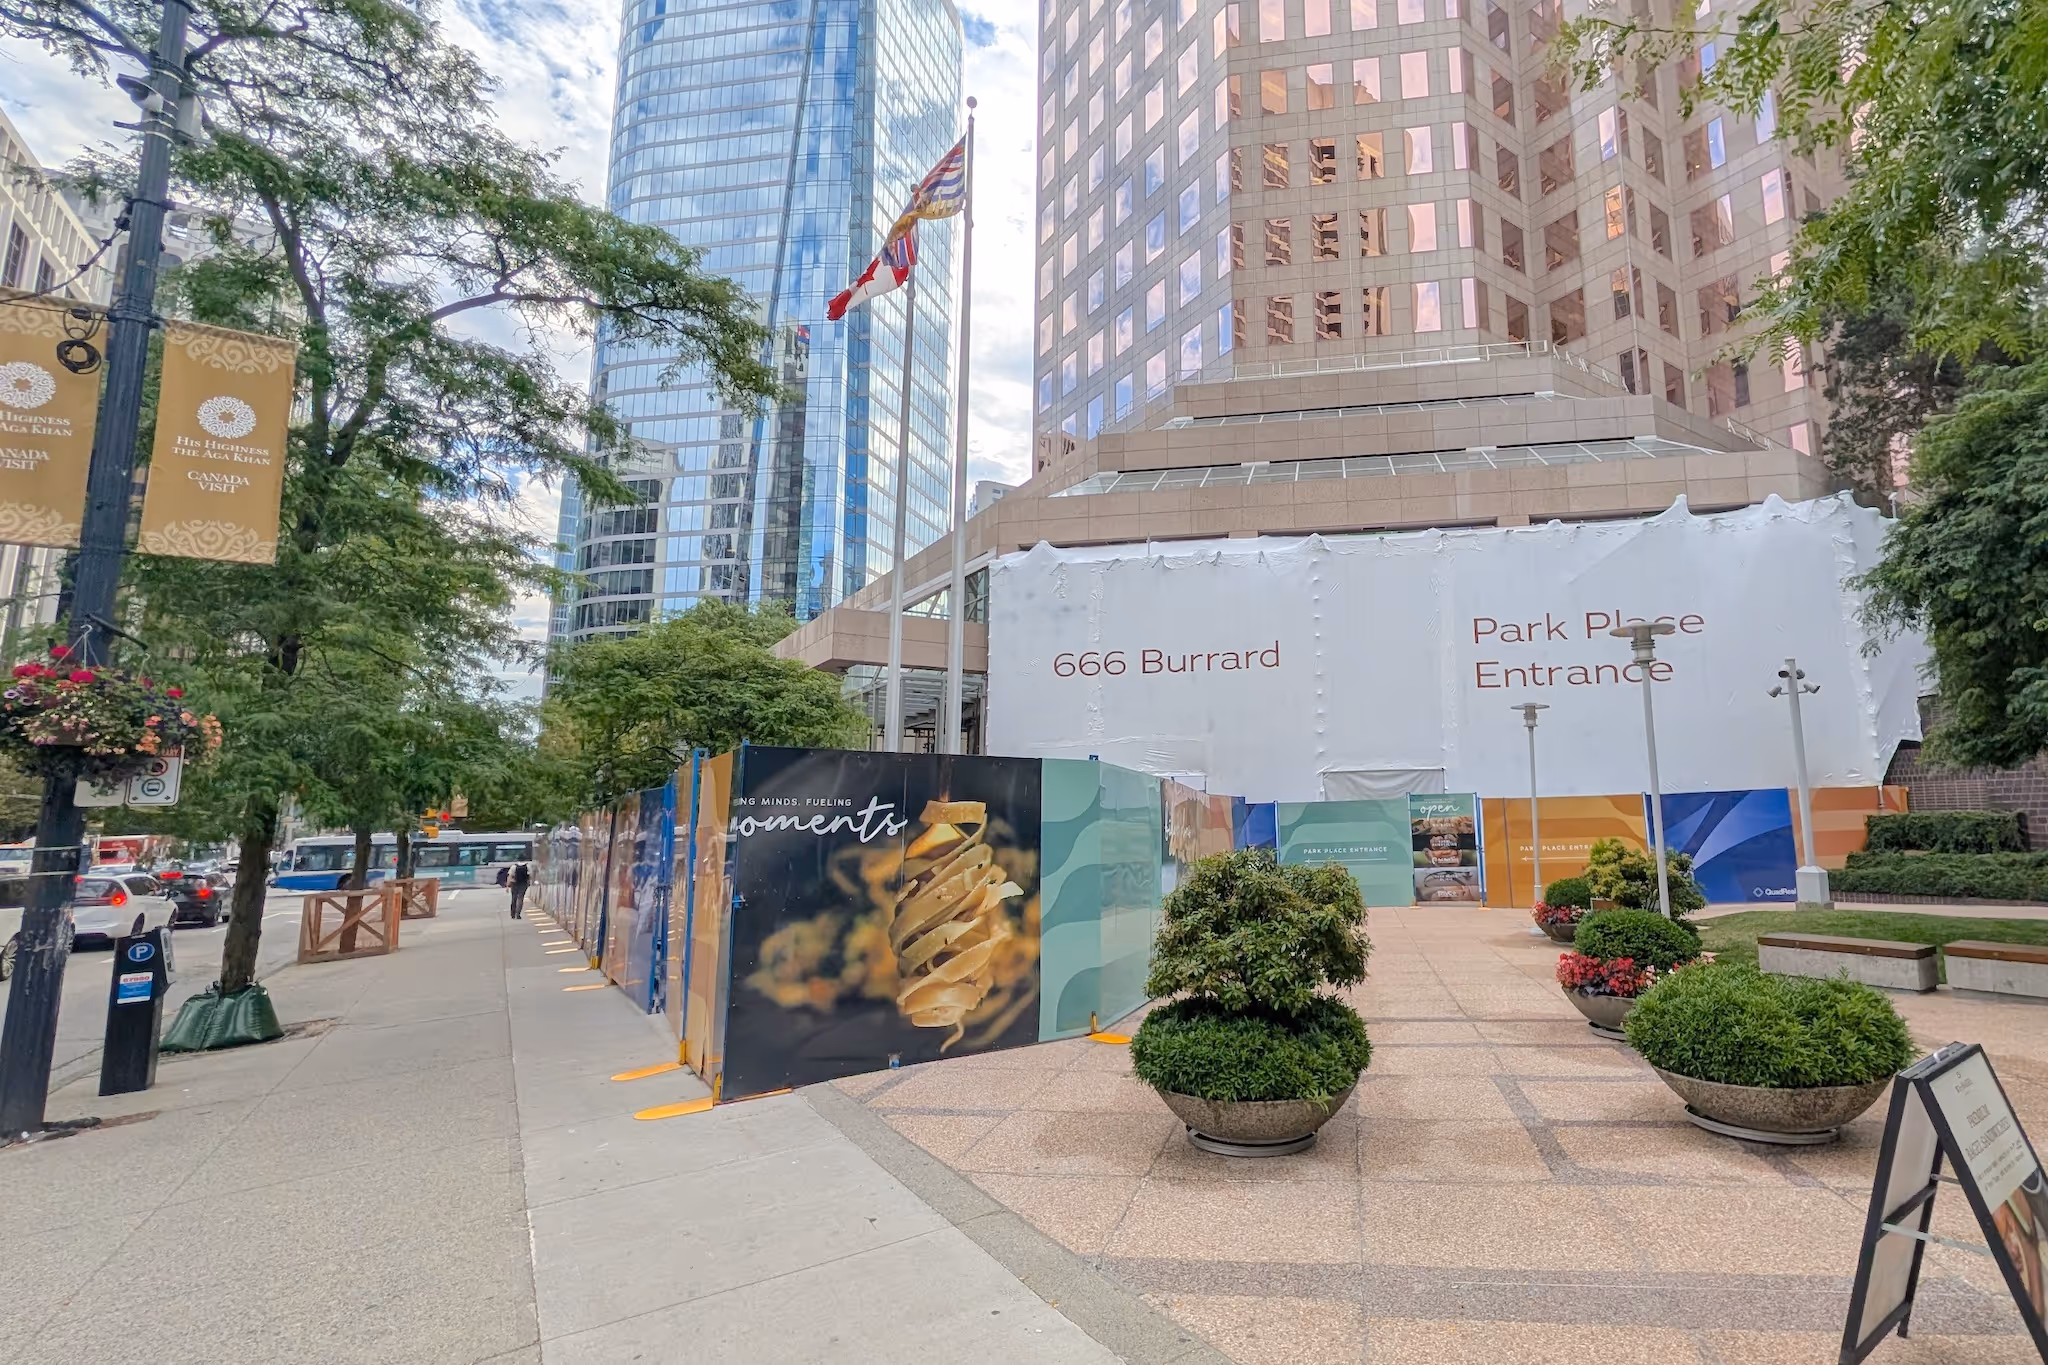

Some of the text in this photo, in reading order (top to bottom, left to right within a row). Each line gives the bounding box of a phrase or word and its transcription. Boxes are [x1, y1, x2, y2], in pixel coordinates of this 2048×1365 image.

[32, 425, 73, 437] KHAN
[0, 447, 50, 461] ANADA
[176, 435, 270, 456] HIS HIGHNESS
[171, 446, 271, 465] THE AGA KHAN
[187, 470, 250, 486] CANADA
[198, 481, 239, 494] VISIT
[1473, 612, 1568, 644] Park
[1053, 640, 1280, 678] 666 Burrard
[1475, 661, 1674, 689] Entrance
[761, 797, 801, 807] MINDS.
[806, 798, 852, 807] FUELING
[1420, 803, 1460, 821] open
[135, 945, 149, 959] P
